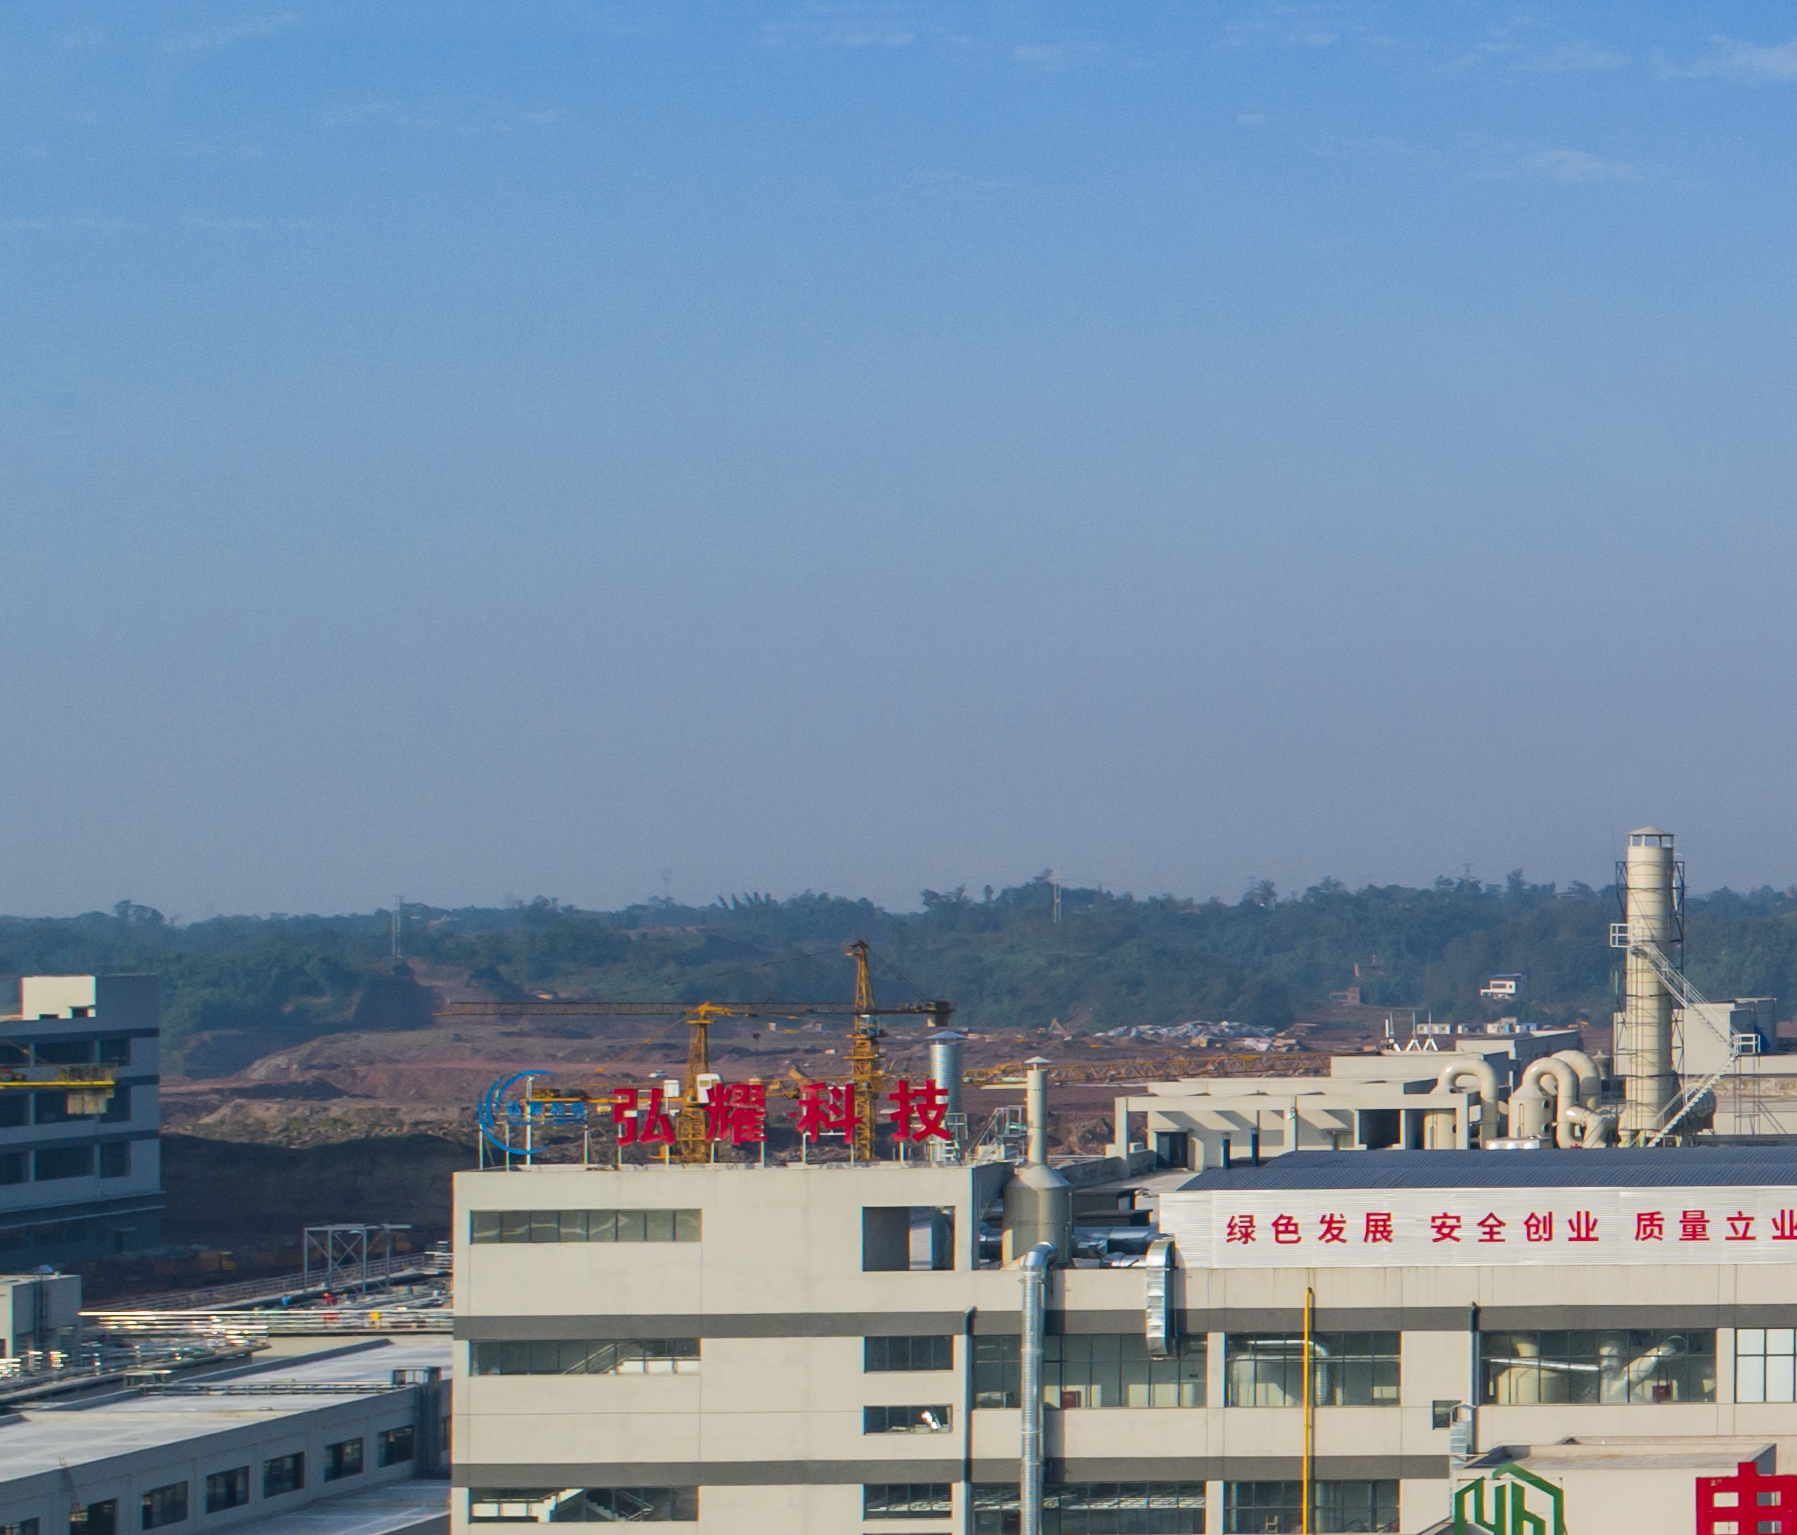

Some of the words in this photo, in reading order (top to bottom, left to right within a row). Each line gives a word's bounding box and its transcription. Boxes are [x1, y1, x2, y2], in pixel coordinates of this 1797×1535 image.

[612, 1079, 954, 1147] 弘耀科技
[1226, 1212, 1394, 1245] 绿色发展
[1430, 1211, 1600, 1244] 安全创业
